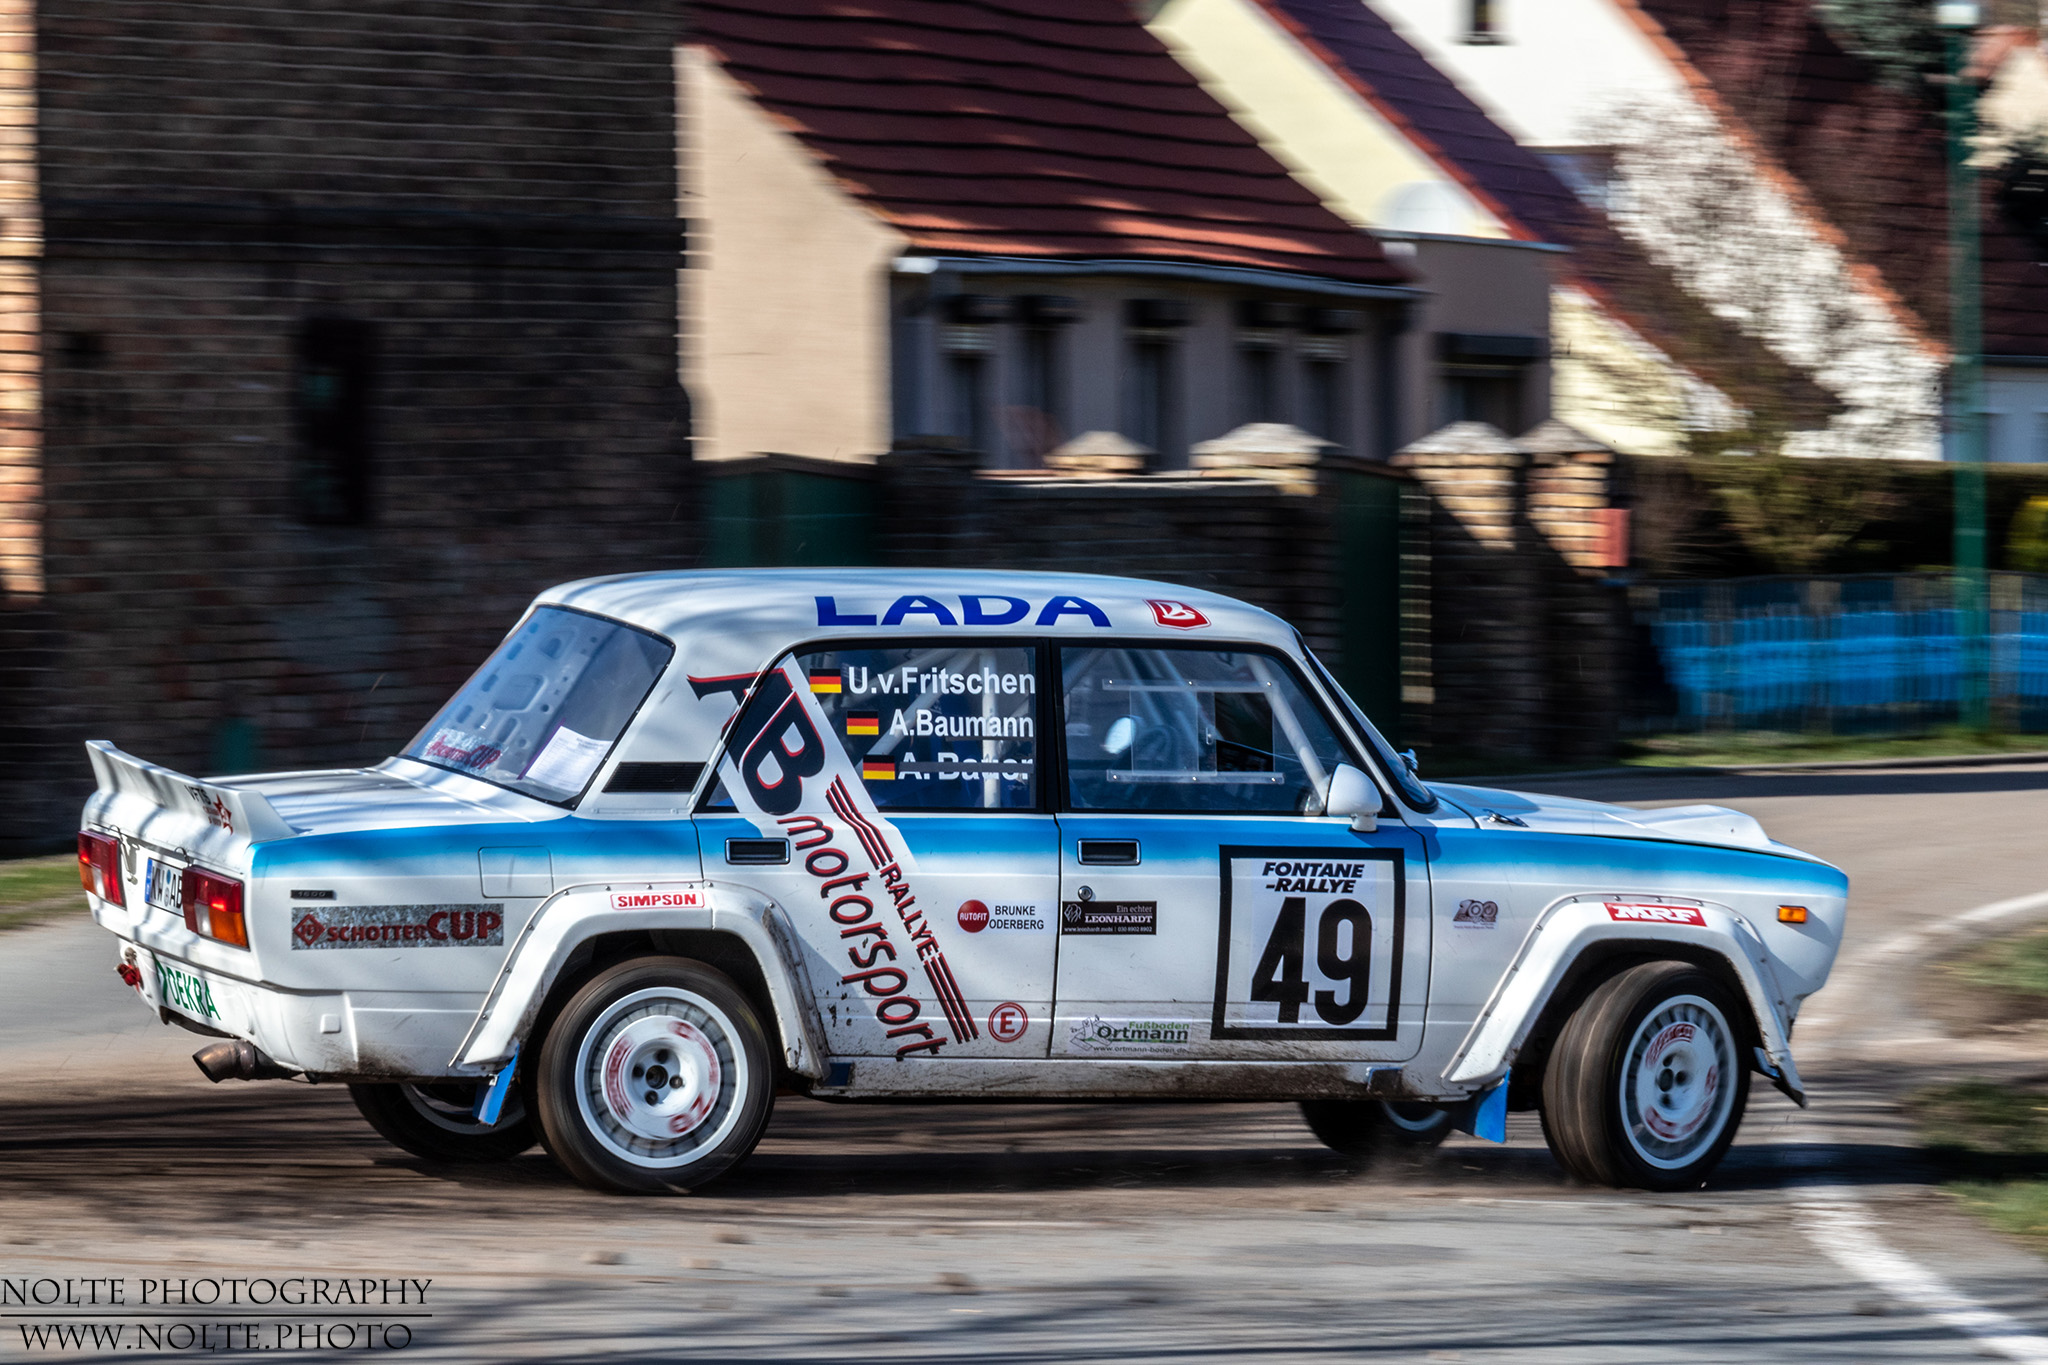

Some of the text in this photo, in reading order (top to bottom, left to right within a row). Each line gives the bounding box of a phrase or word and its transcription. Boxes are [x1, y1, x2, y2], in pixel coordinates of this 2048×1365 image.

[815, 595, 1112, 628] LADA
[848, 666, 1037, 695] U.v.Fritschen
[889, 708, 1035, 737] A.Baumann
[1262, 861, 1365, 878] FONTANE
[1265, 877, 1357, 894] -RALLYE
[617, 893, 697, 908] SIMPSON
[1116, 905, 1153, 913] Ein echter
[880, 861, 940, 962] RALLYE
[960, 912, 987, 921] AUTOFIT
[994, 905, 1036, 916] BRUNKE
[1611, 905, 1698, 923] MRF
[989, 918, 1045, 930] ODERBERG
[1084, 915, 1153, 924] LEONHARDT
[777, 815, 949, 1062] motorsport
[1250, 896, 1373, 1026] 49
[166, 966, 222, 1021] DEKRA
[999, 1011, 1016, 1034] E
[1129, 1021, 1190, 1030] Fußboden
[1097, 1026, 1189, 1040] Ortmann
